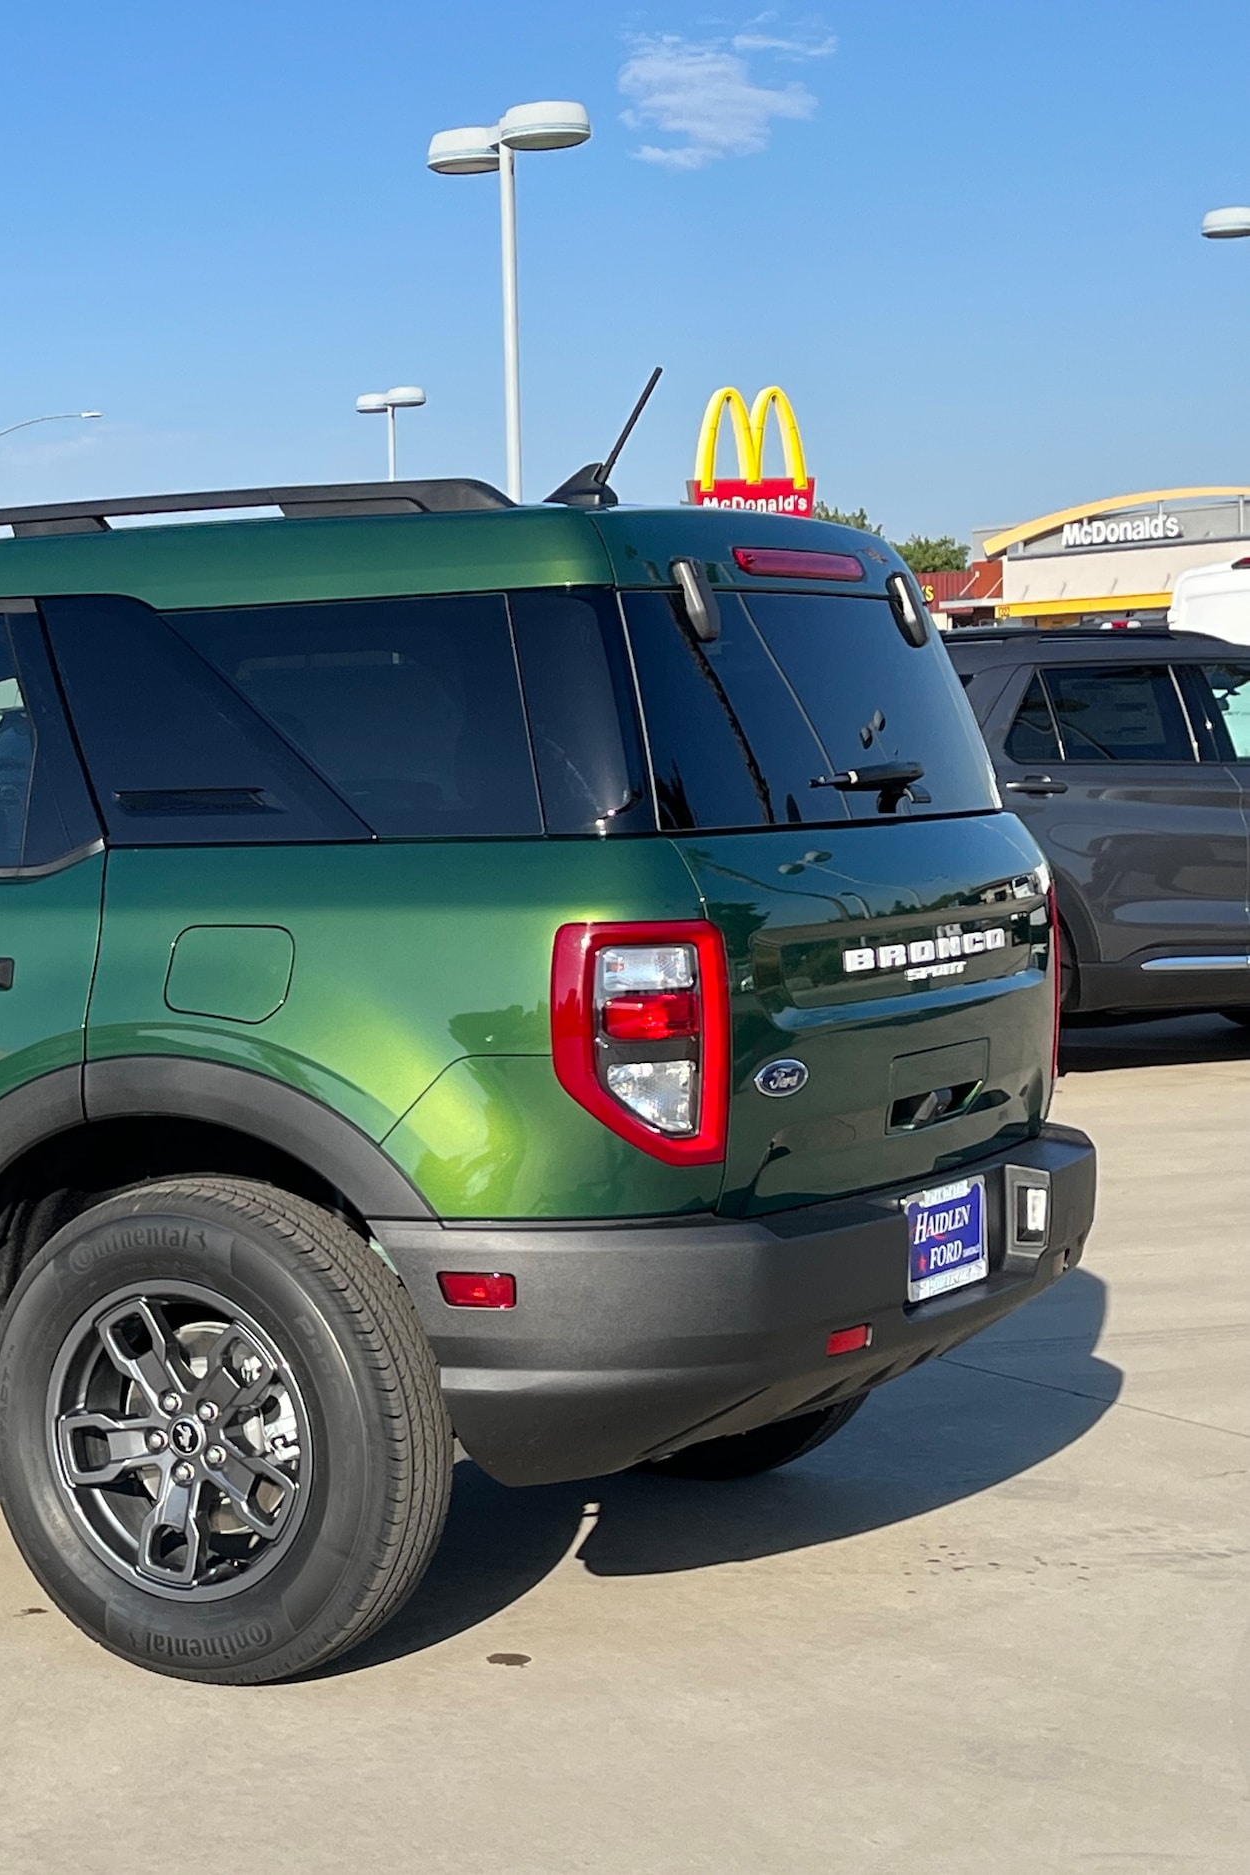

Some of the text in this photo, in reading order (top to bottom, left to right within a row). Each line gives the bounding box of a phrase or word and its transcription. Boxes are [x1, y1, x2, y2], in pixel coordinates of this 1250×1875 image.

[702, 494, 808, 513] McDonald's
[1061, 515, 1180, 546] McDonald's
[843, 928, 1006, 973] BRONCO
[904, 960, 968, 982] SPORT
[913, 1204, 971, 1245] HAIDLEN
[68, 1225, 191, 1276] Continental
[930, 1240, 963, 1270] FORD
[146, 1619, 273, 1660] Continental
